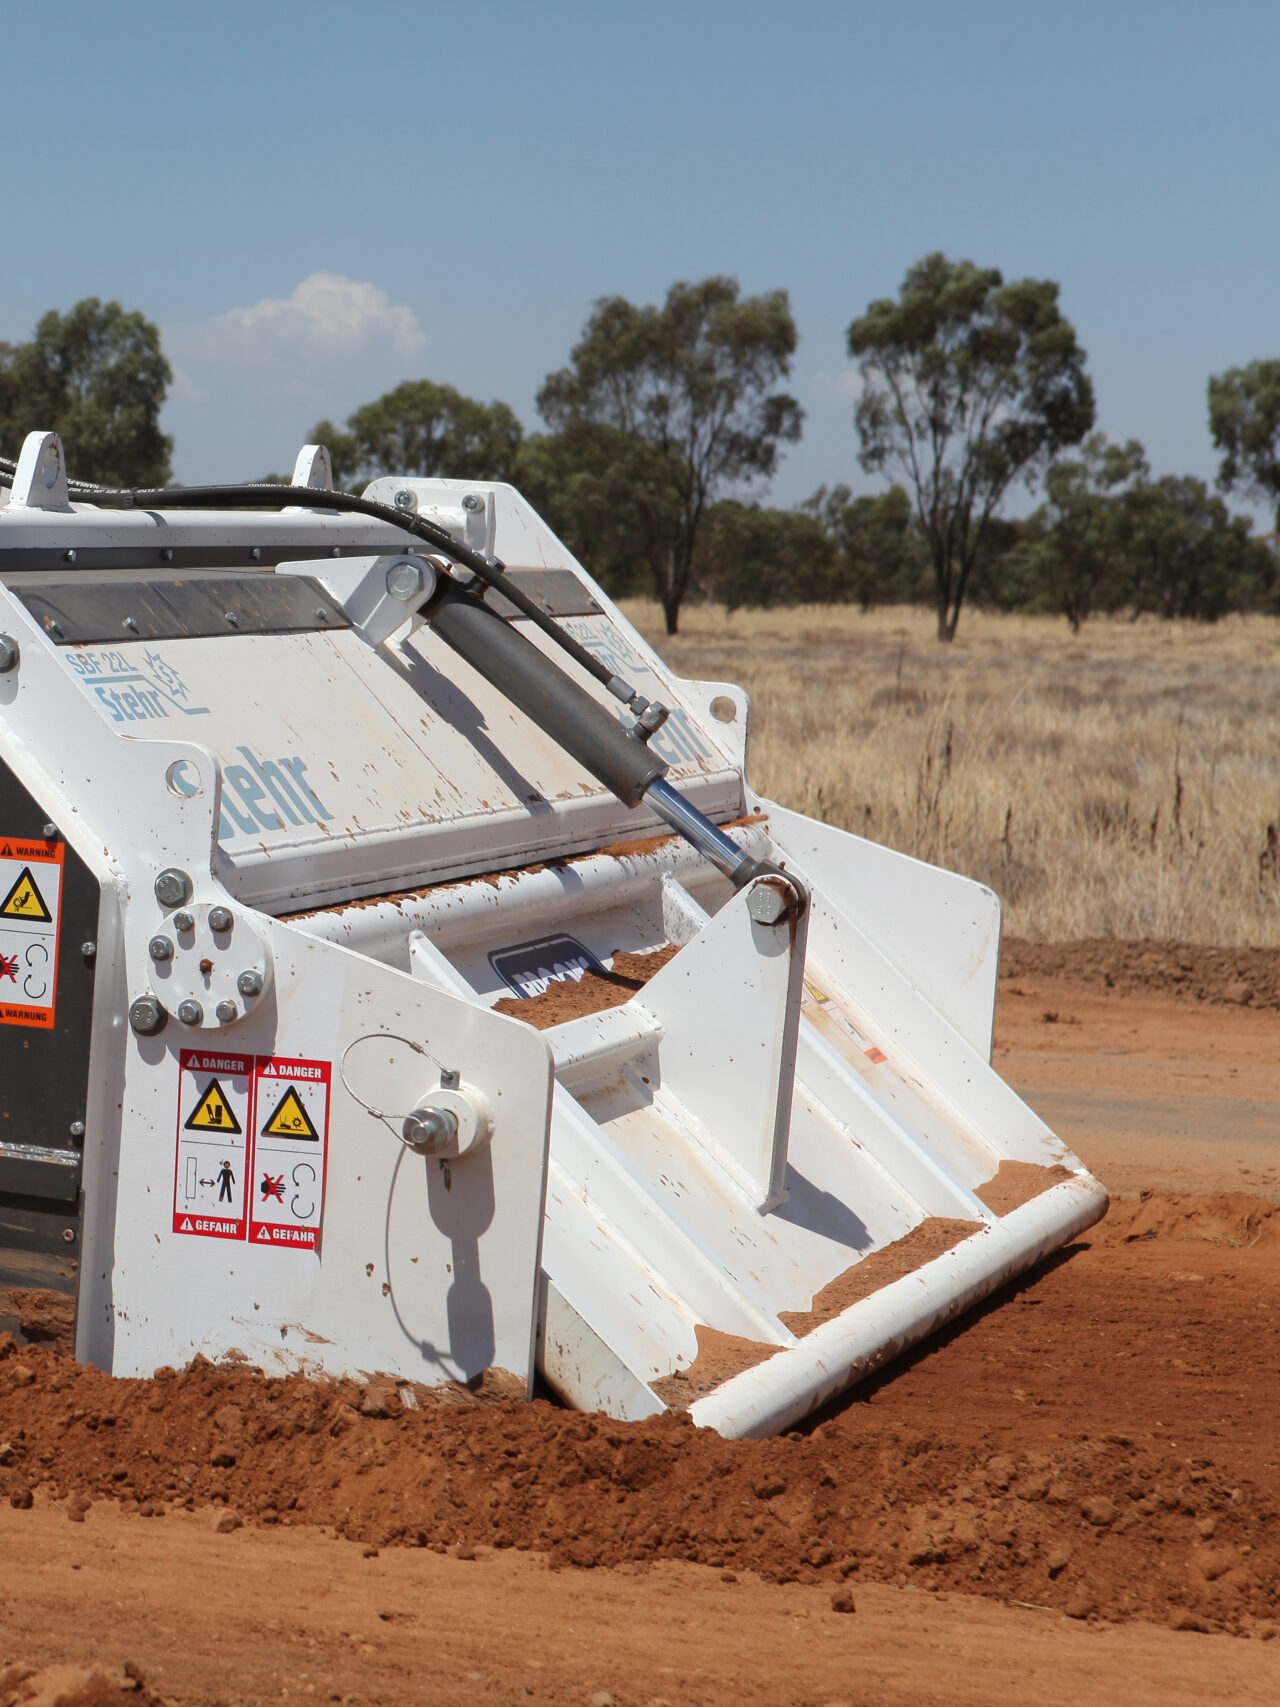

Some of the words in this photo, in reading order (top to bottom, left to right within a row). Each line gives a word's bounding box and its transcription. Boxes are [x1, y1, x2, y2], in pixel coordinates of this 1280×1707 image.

[65, 652, 106, 676] SBF
[104, 650, 139, 672] 22L
[94, 684, 171, 722] Stehr
[217, 745, 336, 841] tehr
[16, 847, 56, 859] WARNING
[5, 1008, 47, 1022] WARNUNG
[202, 1057, 245, 1072] DANGER
[279, 1065, 323, 1079] DANGER
[195, 1219, 238, 1234] GEFAHR
[272, 1227, 316, 1243] GEFAHR
